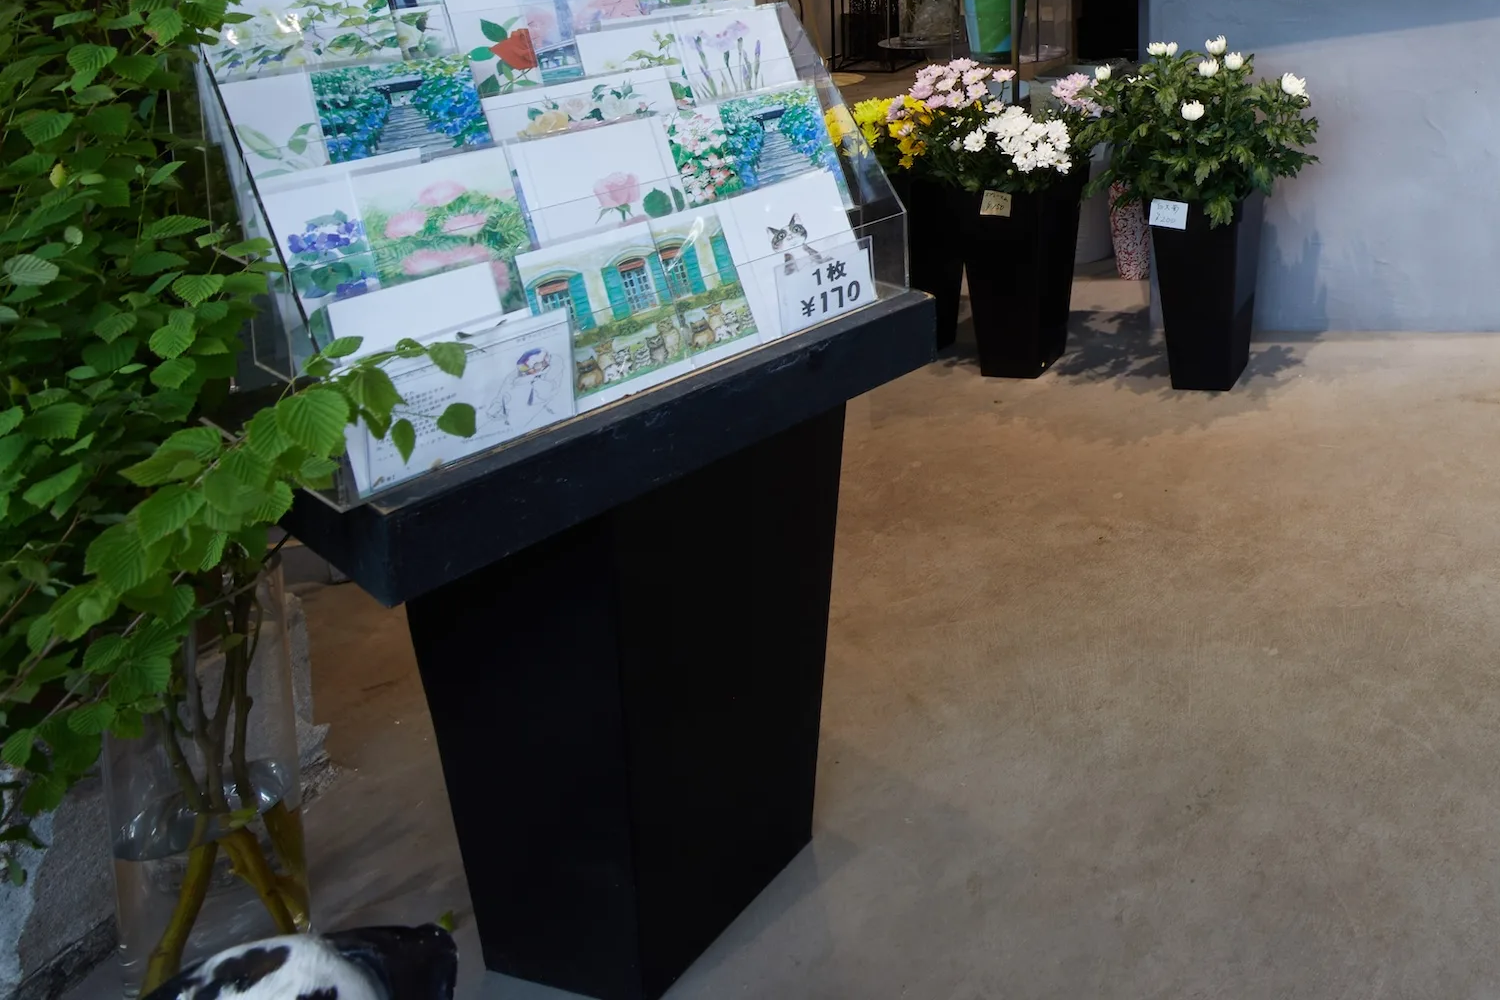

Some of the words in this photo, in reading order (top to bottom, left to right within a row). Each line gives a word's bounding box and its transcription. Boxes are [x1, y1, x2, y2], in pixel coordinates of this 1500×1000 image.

[1155, 212, 1176, 223] ¥200
[812, 260, 847, 286] 1枚
[800, 280, 861, 318] ¥170
